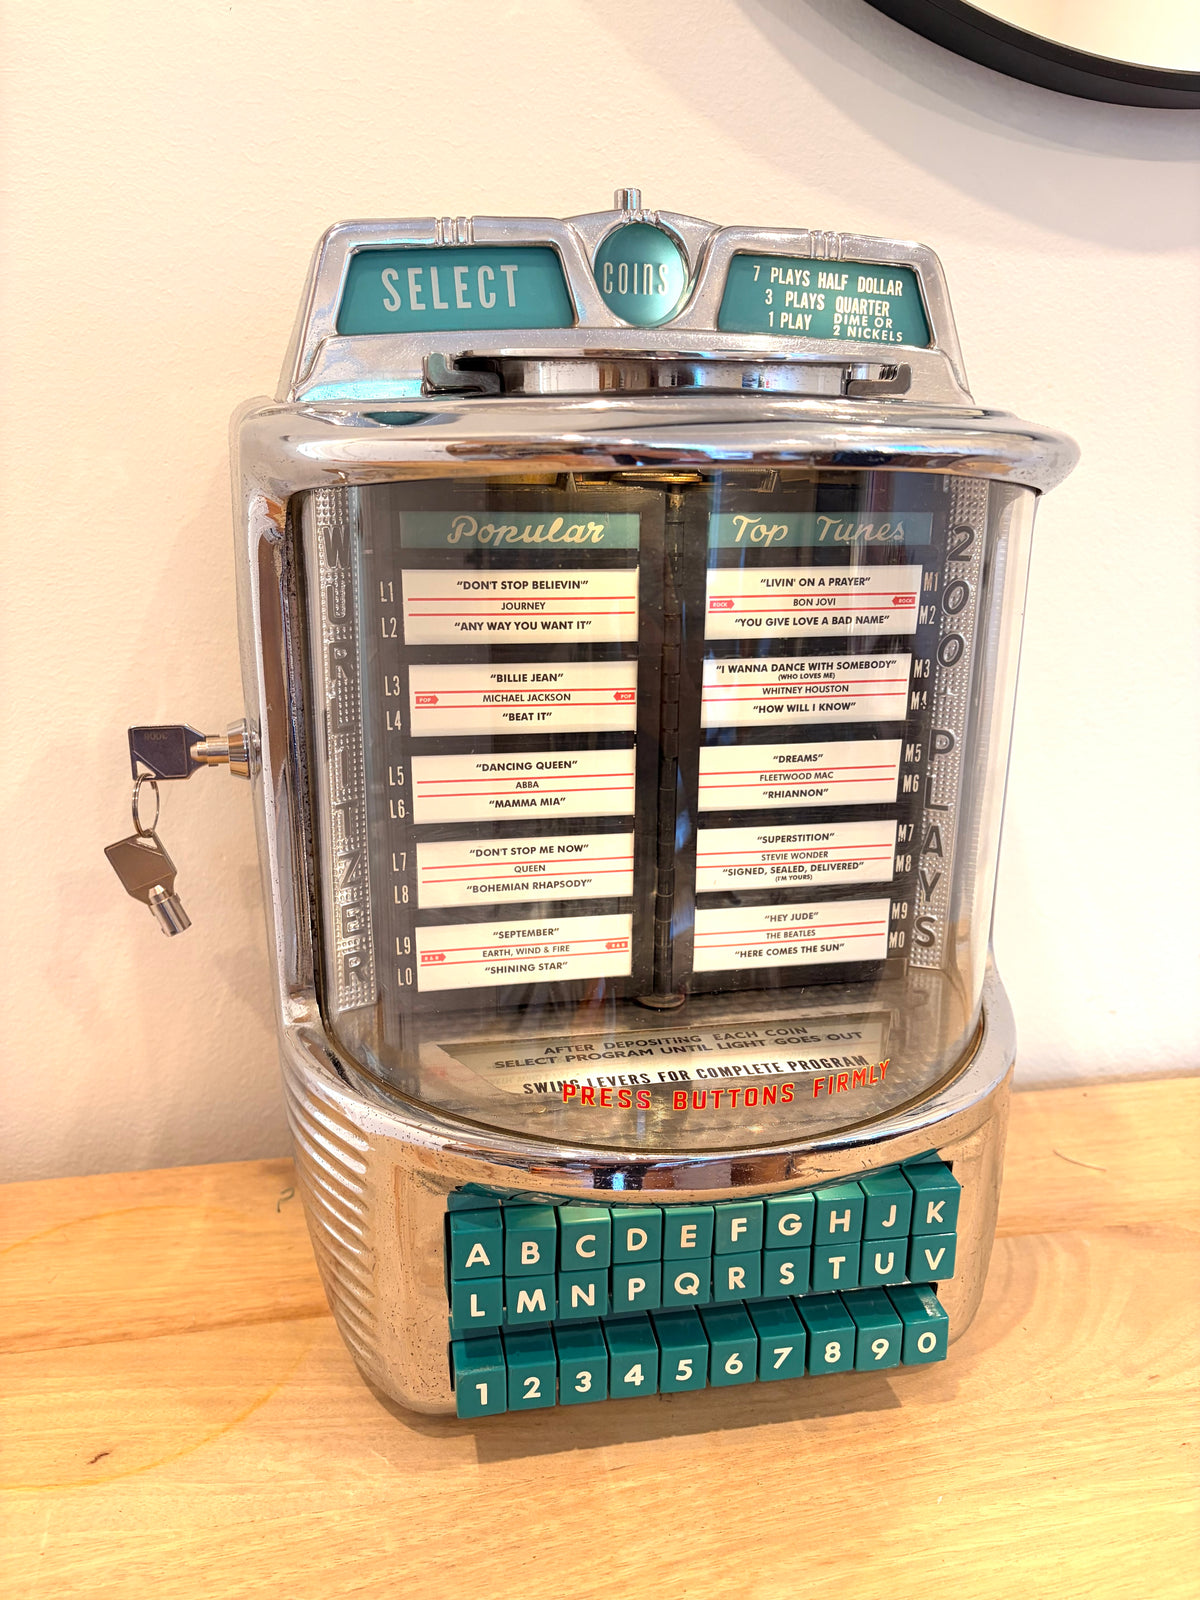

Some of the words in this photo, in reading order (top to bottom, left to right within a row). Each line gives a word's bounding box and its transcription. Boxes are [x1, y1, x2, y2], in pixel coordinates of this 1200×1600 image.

[603, 261, 669, 296] COINS
[754, 265, 760, 281] 7
[770, 267, 810, 287] PLAYS
[817, 272, 849, 291] HALF
[857, 276, 903, 296] DOLLAR
[381, 265, 518, 312] SELECT
[765, 289, 772, 305] 3
[785, 291, 825, 311] PLAYS
[835, 295, 890, 317] QUARTER
[769, 311, 774, 327] 1
[780, 312, 812, 331] PLAY
[834, 313, 869, 326] DIME
[875, 316, 893, 328] OR
[833, 324, 841, 336] 2
[847, 325, 902, 342] NICKELS
[447, 515, 605, 546] Popular
[732, 514, 788, 547] Top
[817, 516, 904, 546] Tunes
[457, 581, 498, 590] “DON'T
[501, 581, 529, 590] STOP
[760, 578, 796, 587] “LIVIN'
[799, 578, 815, 587] ON
[818, 578, 825, 586] A
[828, 577, 871, 586] PRAYER”
[501, 602, 546, 610] JOURNEY
[793, 598, 813, 606] BON
[815, 598, 836, 606] JOVI
[454, 622, 484, 631] “ANY
[486, 622, 512, 631] WAY
[514, 621, 537, 630] YOU
[540, 621, 573, 630] WANT
[577, 621, 592, 629] IT”
[735, 618, 762, 627] “YOU
[765, 617, 790, 626] GIVE
[793, 617, 819, 626] LOVE
[821, 617, 829, 625] A
[831, 616, 852, 625] BAD
[855, 615, 890, 624] NAME”
[728, 664, 768, 673] WANNA
[771, 663, 805, 672] DANCE
[808, 662, 834, 671] WITH
[836, 660, 897, 670] SOMEBODY”
[490, 674, 527, 683] “BILLIE
[530, 673, 563, 682] JEAN”
[778, 673, 798, 681] (WHO
[823, 672, 836, 680] ME)
[762, 686, 803, 695] WHITNEY
[805, 685, 849, 693] HOUSTON
[483, 694, 525, 702] MICHAEL
[527, 693, 571, 702] JACKSON
[753, 705, 784, 713] “HOW
[786, 704, 809, 712] WILL
[812, 703, 815, 711] I
[819, 702, 856, 711] KNOW”
[502, 712, 534, 721] “BEAT
[537, 712, 552, 721] IT”
[773, 754, 823, 763] “DREAMS”
[476, 762, 533, 772] “DANCING
[536, 760, 578, 770] QUEEN”
[760, 772, 812, 781] FLEETWOOD
[814, 771, 834, 779] MAC
[515, 781, 539, 789] ABBA
[763, 788, 829, 799] “RHIANNON”
[489, 798, 537, 808] “MAMMA
[540, 797, 566, 806] MIA”
[757, 833, 835, 844] “SUPERSTITION”
[470, 848, 508, 857] “DON'T
[511, 847, 536, 855] STOP
[539, 846, 554, 854] ME
[557, 844, 589, 853] NOW”
[761, 853, 788, 861] STEVIE
[790, 851, 828, 859] WONDER
[514, 865, 546, 873] QUEEN
[723, 867, 767, 876] “SIGNED,
[770, 865, 807, 874] SEALED,
[810, 862, 864, 872] DELIVERED”
[467, 882, 529, 893] “BOHEMIAN
[532, 879, 592, 890] RHAPSODY”
[765, 914, 788, 922] “HEY
[790, 912, 819, 921] JUDE”
[493, 928, 559, 939] “SEPTEMBER”
[783, 929, 816, 938] BEATLES
[482, 949, 513, 957] EARTH,
[516, 947, 541, 955] WIND
[735, 949, 763, 958] “HERE
[766, 947, 798, 956] COMES
[801, 945, 818, 953] THE
[820, 943, 844, 952] SUN”
[485, 964, 535, 974] “SHINING
[538, 962, 568, 971] STAR”
[544, 1044, 595, 1055] AFTER
[603, 1038, 702, 1049] DEPOSITING
[712, 1031, 758, 1041] EACH
[765, 1027, 808, 1036] COIN
[494, 1056, 558, 1069] SELECT
[565, 1048, 654, 1063] PROGRAM
[660, 1044, 714, 1054] UNTIL
[716, 1039, 766, 1050] LIGHT
[774, 1035, 822, 1045] GOES
[825, 1031, 862, 1041] OUT
[523, 1078, 581, 1095] SWING
[587, 1072, 652, 1089] LEVERS
[658, 1069, 691, 1083] FOR
[696, 1061, 783, 1080] COMPLETE
[787, 1055, 870, 1072] PROGRAM
[563, 1083, 650, 1109] PRESS
[673, 1084, 794, 1110] BUTTONS
[814, 1059, 889, 1098] FIRMLY
[465, 1243, 490, 1268] A
[521, 1241, 540, 1265] B
[576, 1234, 596, 1258] C
[627, 1228, 648, 1251] D
[680, 1224, 697, 1248] E
[731, 1217, 747, 1242] F
[778, 1213, 802, 1236] G
[829, 1209, 851, 1233] H
[882, 1205, 897, 1227] J
[926, 1200, 946, 1224] K
[470, 1294, 485, 1317] L
[517, 1288, 547, 1313] M
[572, 1284, 595, 1308] N
[628, 1278, 646, 1301] P
[674, 1272, 700, 1296] Q
[728, 1267, 746, 1290] R
[779, 1262, 794, 1285] S
[828, 1256, 846, 1279] T
[875, 1252, 894, 1275] U
[925, 1248, 946, 1270] V
[476, 1383, 488, 1405] 1
[523, 1377, 541, 1399] 2
[575, 1371, 592, 1392] 3
[624, 1364, 644, 1386] 4
[675, 1359, 692, 1381] 5
[725, 1353, 743, 1374] 6
[773, 1347, 793, 1369] 7
[824, 1342, 841, 1363] 8
[871, 1338, 889, 1360] 9
[917, 1332, 937, 1354] 0
